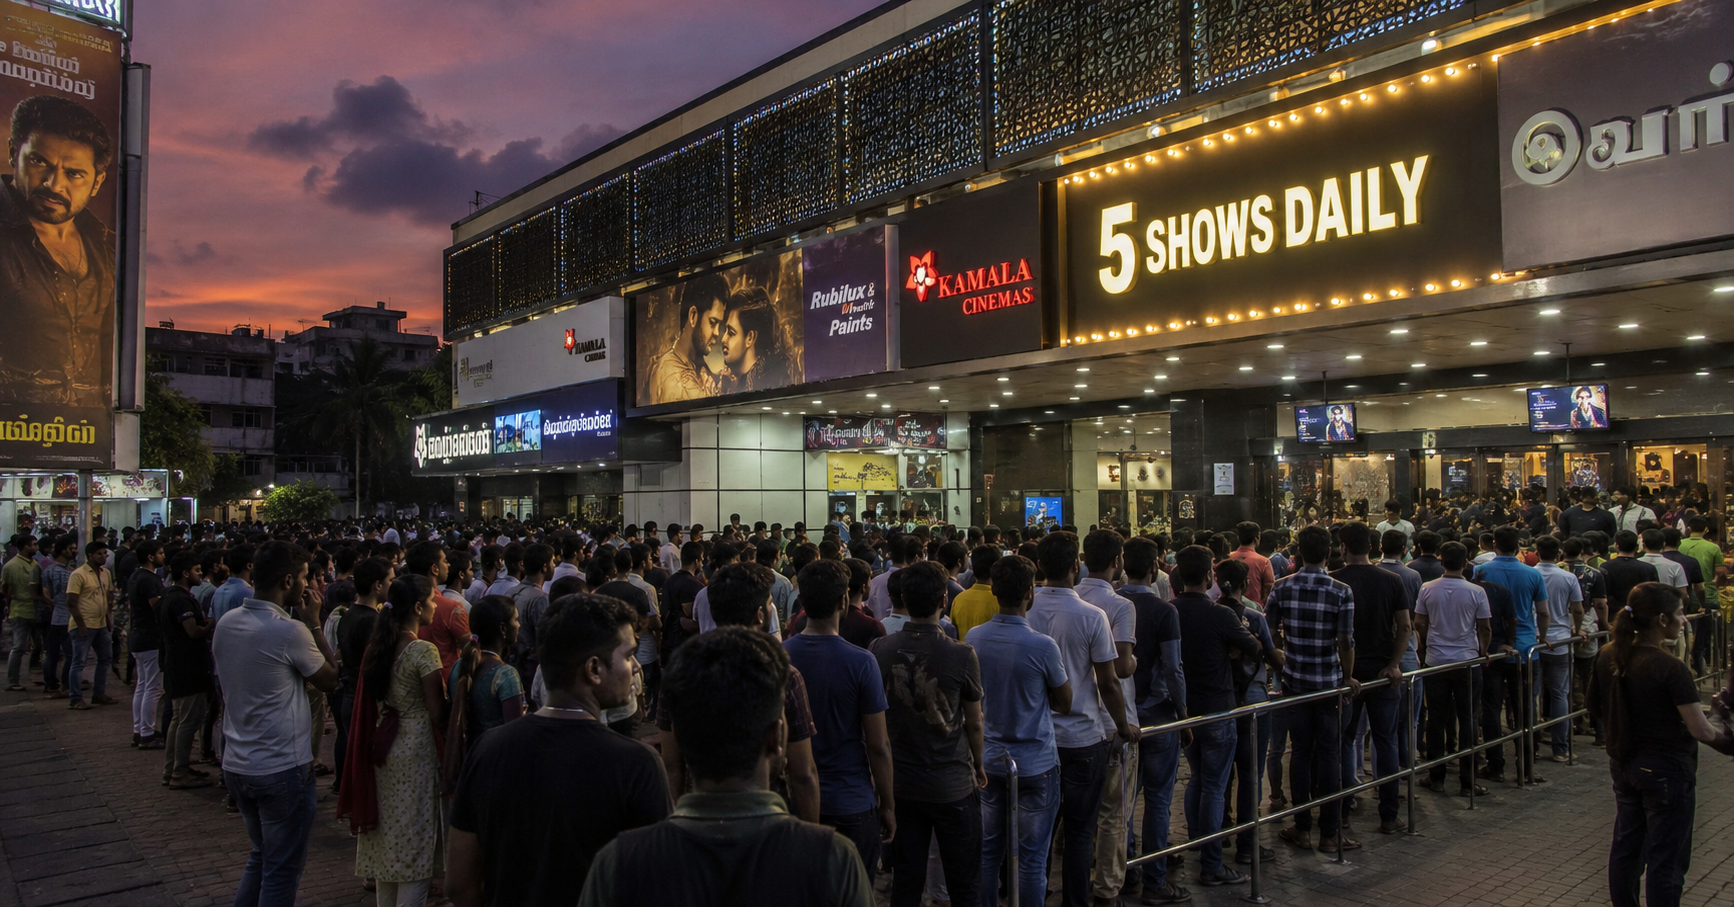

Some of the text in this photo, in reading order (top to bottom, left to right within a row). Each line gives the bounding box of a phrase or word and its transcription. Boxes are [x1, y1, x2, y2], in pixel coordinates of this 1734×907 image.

[1098, 154, 1429, 295] 5 SHOWS DAILY
[937, 258, 1033, 299] KAMALA
[810, 284, 867, 310] Rubilux
[867, 282, 875, 297] &
[962, 287, 1035, 315] CINEMAS
[829, 313, 873, 337] Paints
